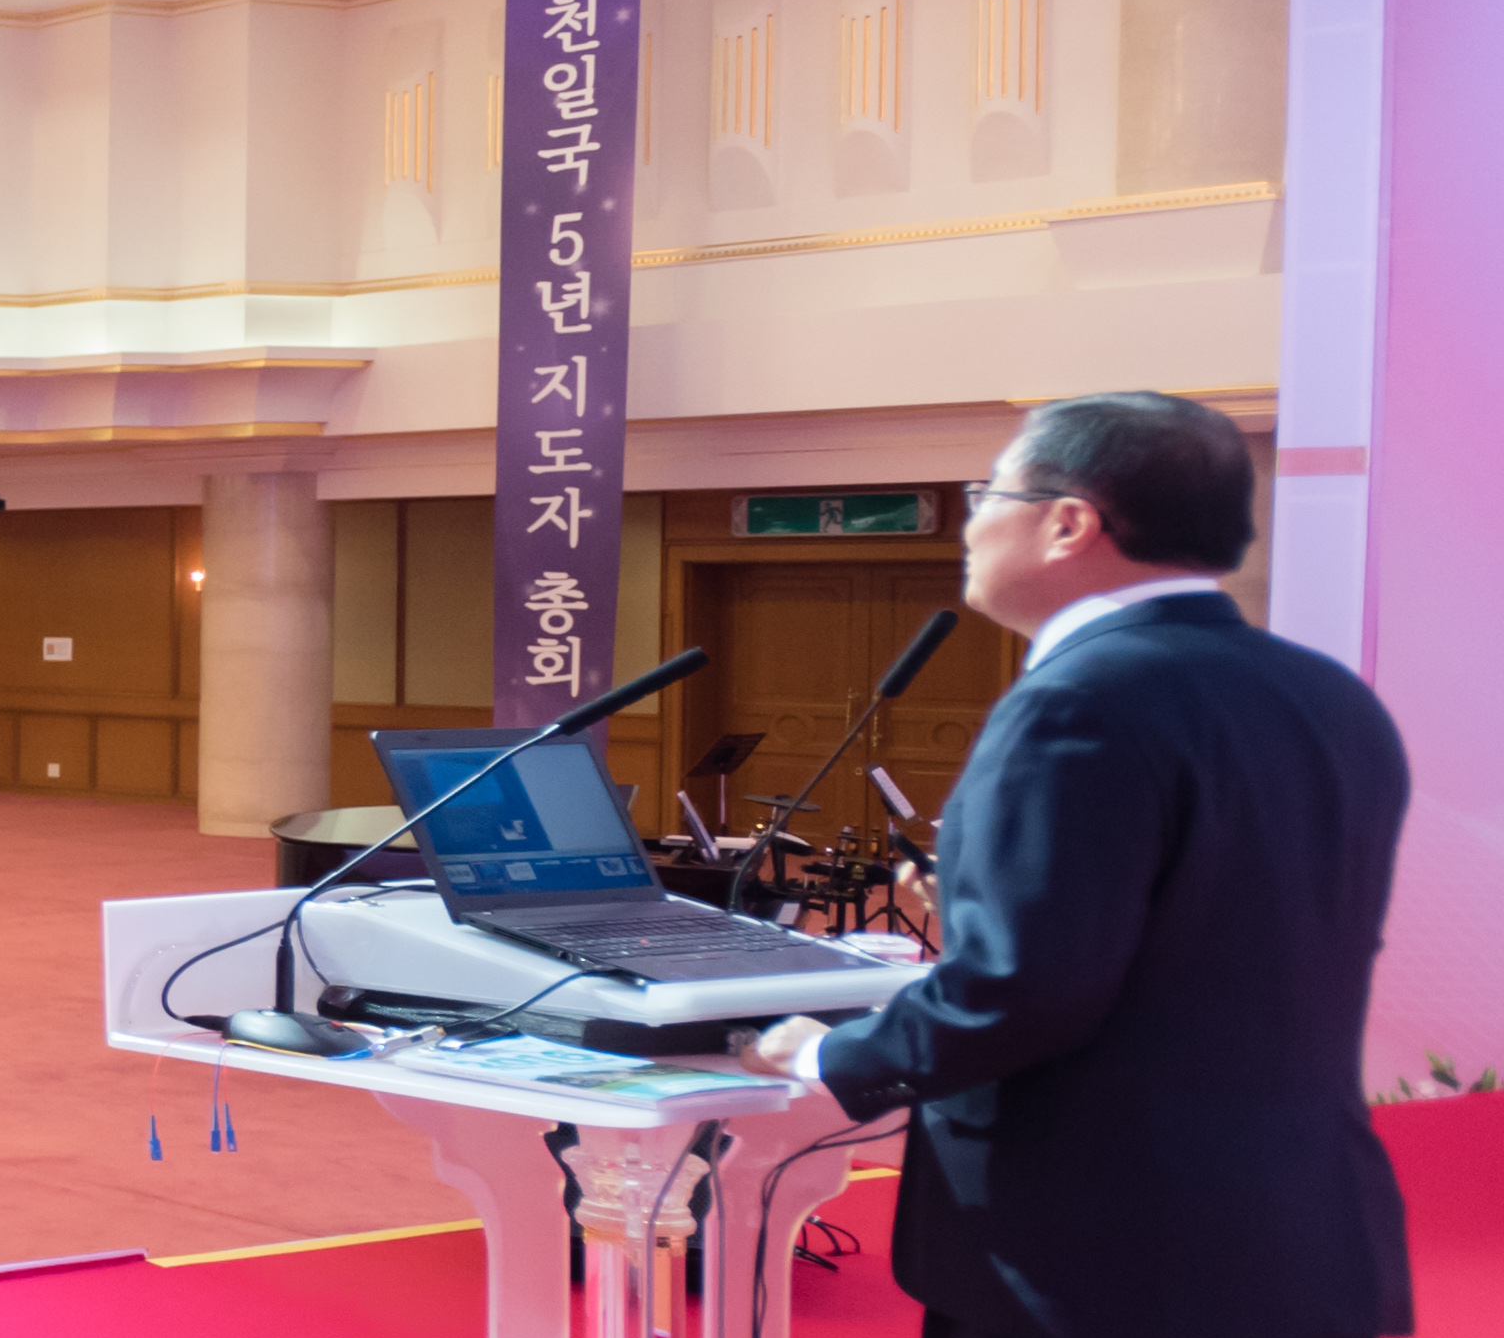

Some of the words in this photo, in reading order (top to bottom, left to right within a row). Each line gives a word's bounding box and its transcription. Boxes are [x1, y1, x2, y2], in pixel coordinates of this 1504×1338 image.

[535, 212, 592, 334] 5년
[527, 355, 593, 548] 지도자
[525, 571, 589, 697] 총회
